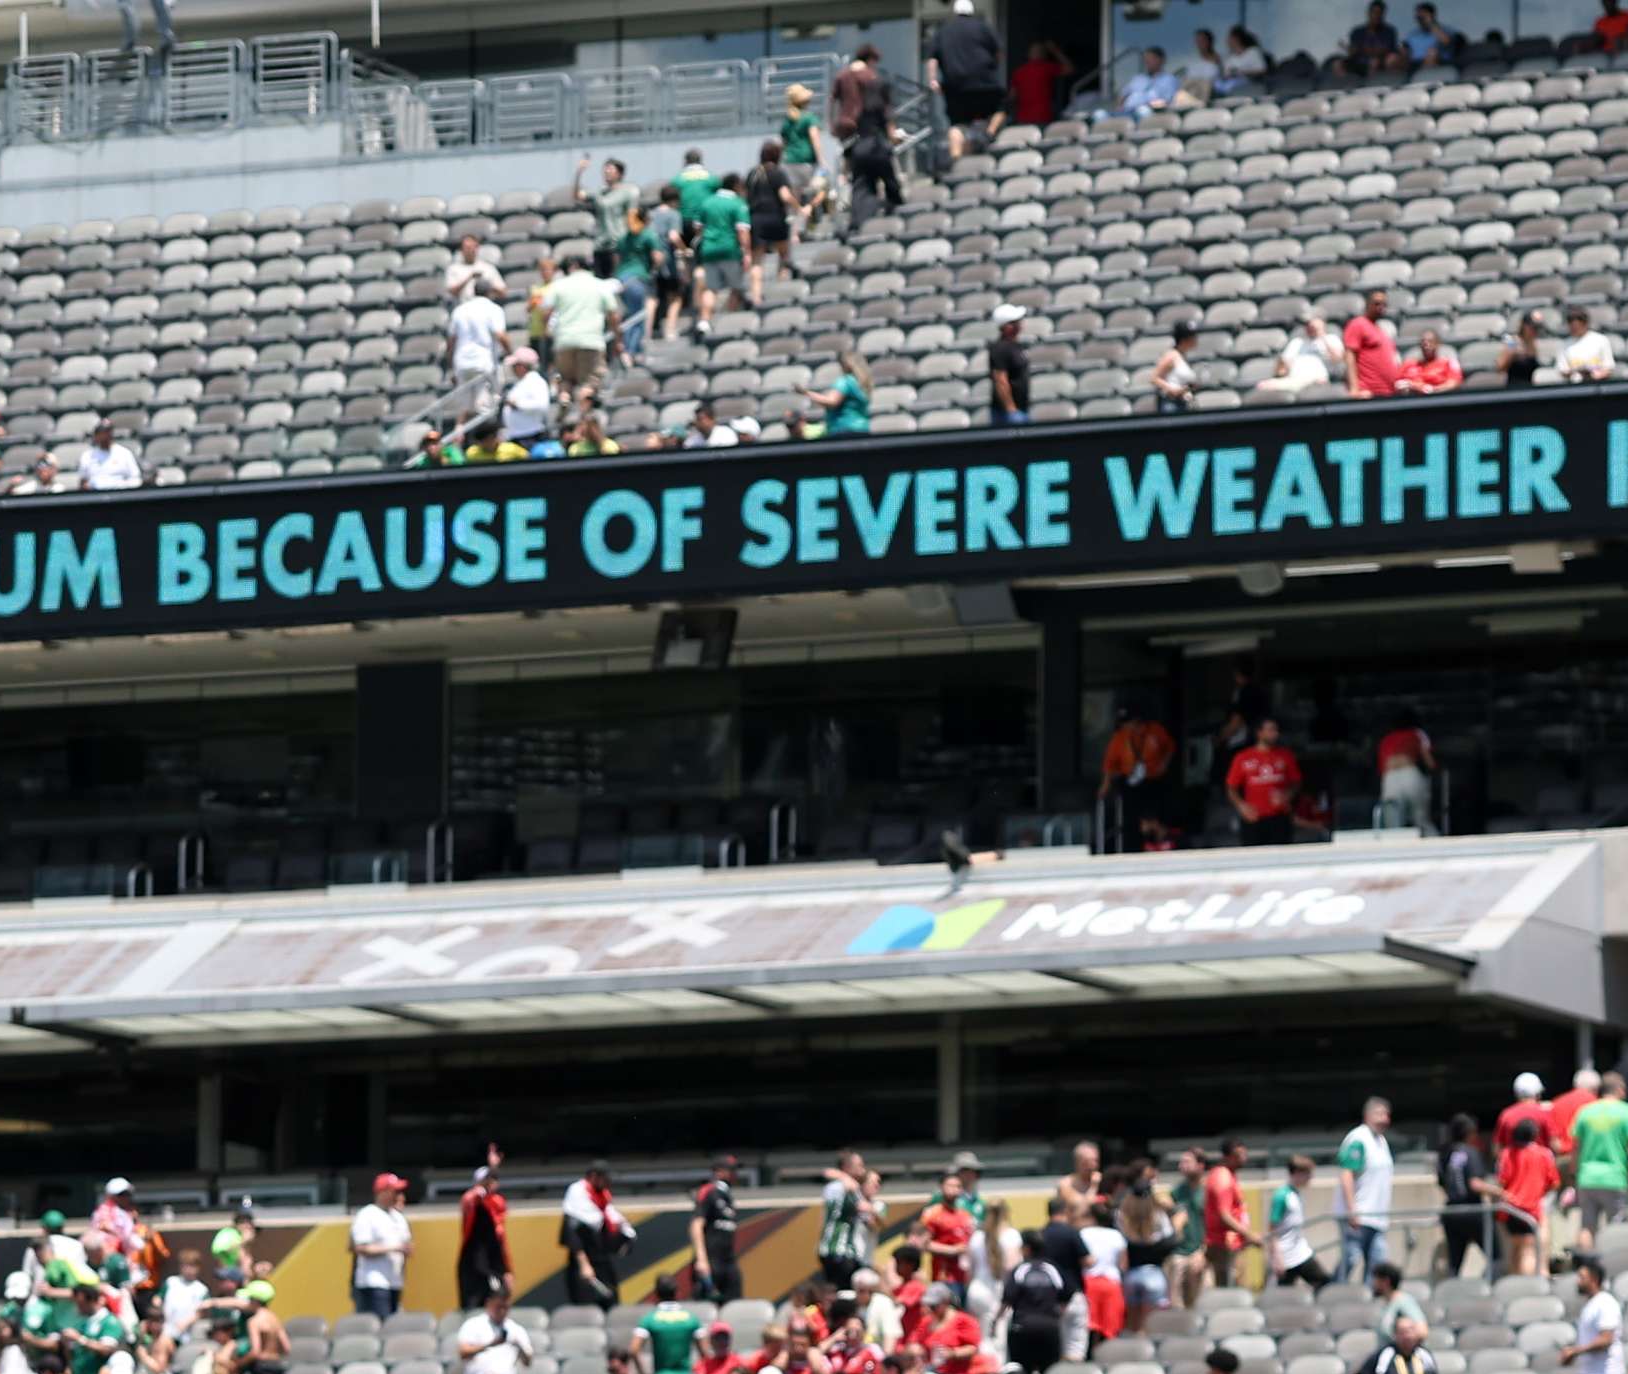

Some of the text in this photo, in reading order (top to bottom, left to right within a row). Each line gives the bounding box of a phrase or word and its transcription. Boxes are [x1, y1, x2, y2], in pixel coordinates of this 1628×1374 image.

[158, 497, 547, 605] BECAUSE
[582, 486, 704, 577] OF
[740, 460, 1070, 567] SEVERE
[1104, 426, 1570, 541] WEATHER
[1000, 886, 1367, 942] MetLife
